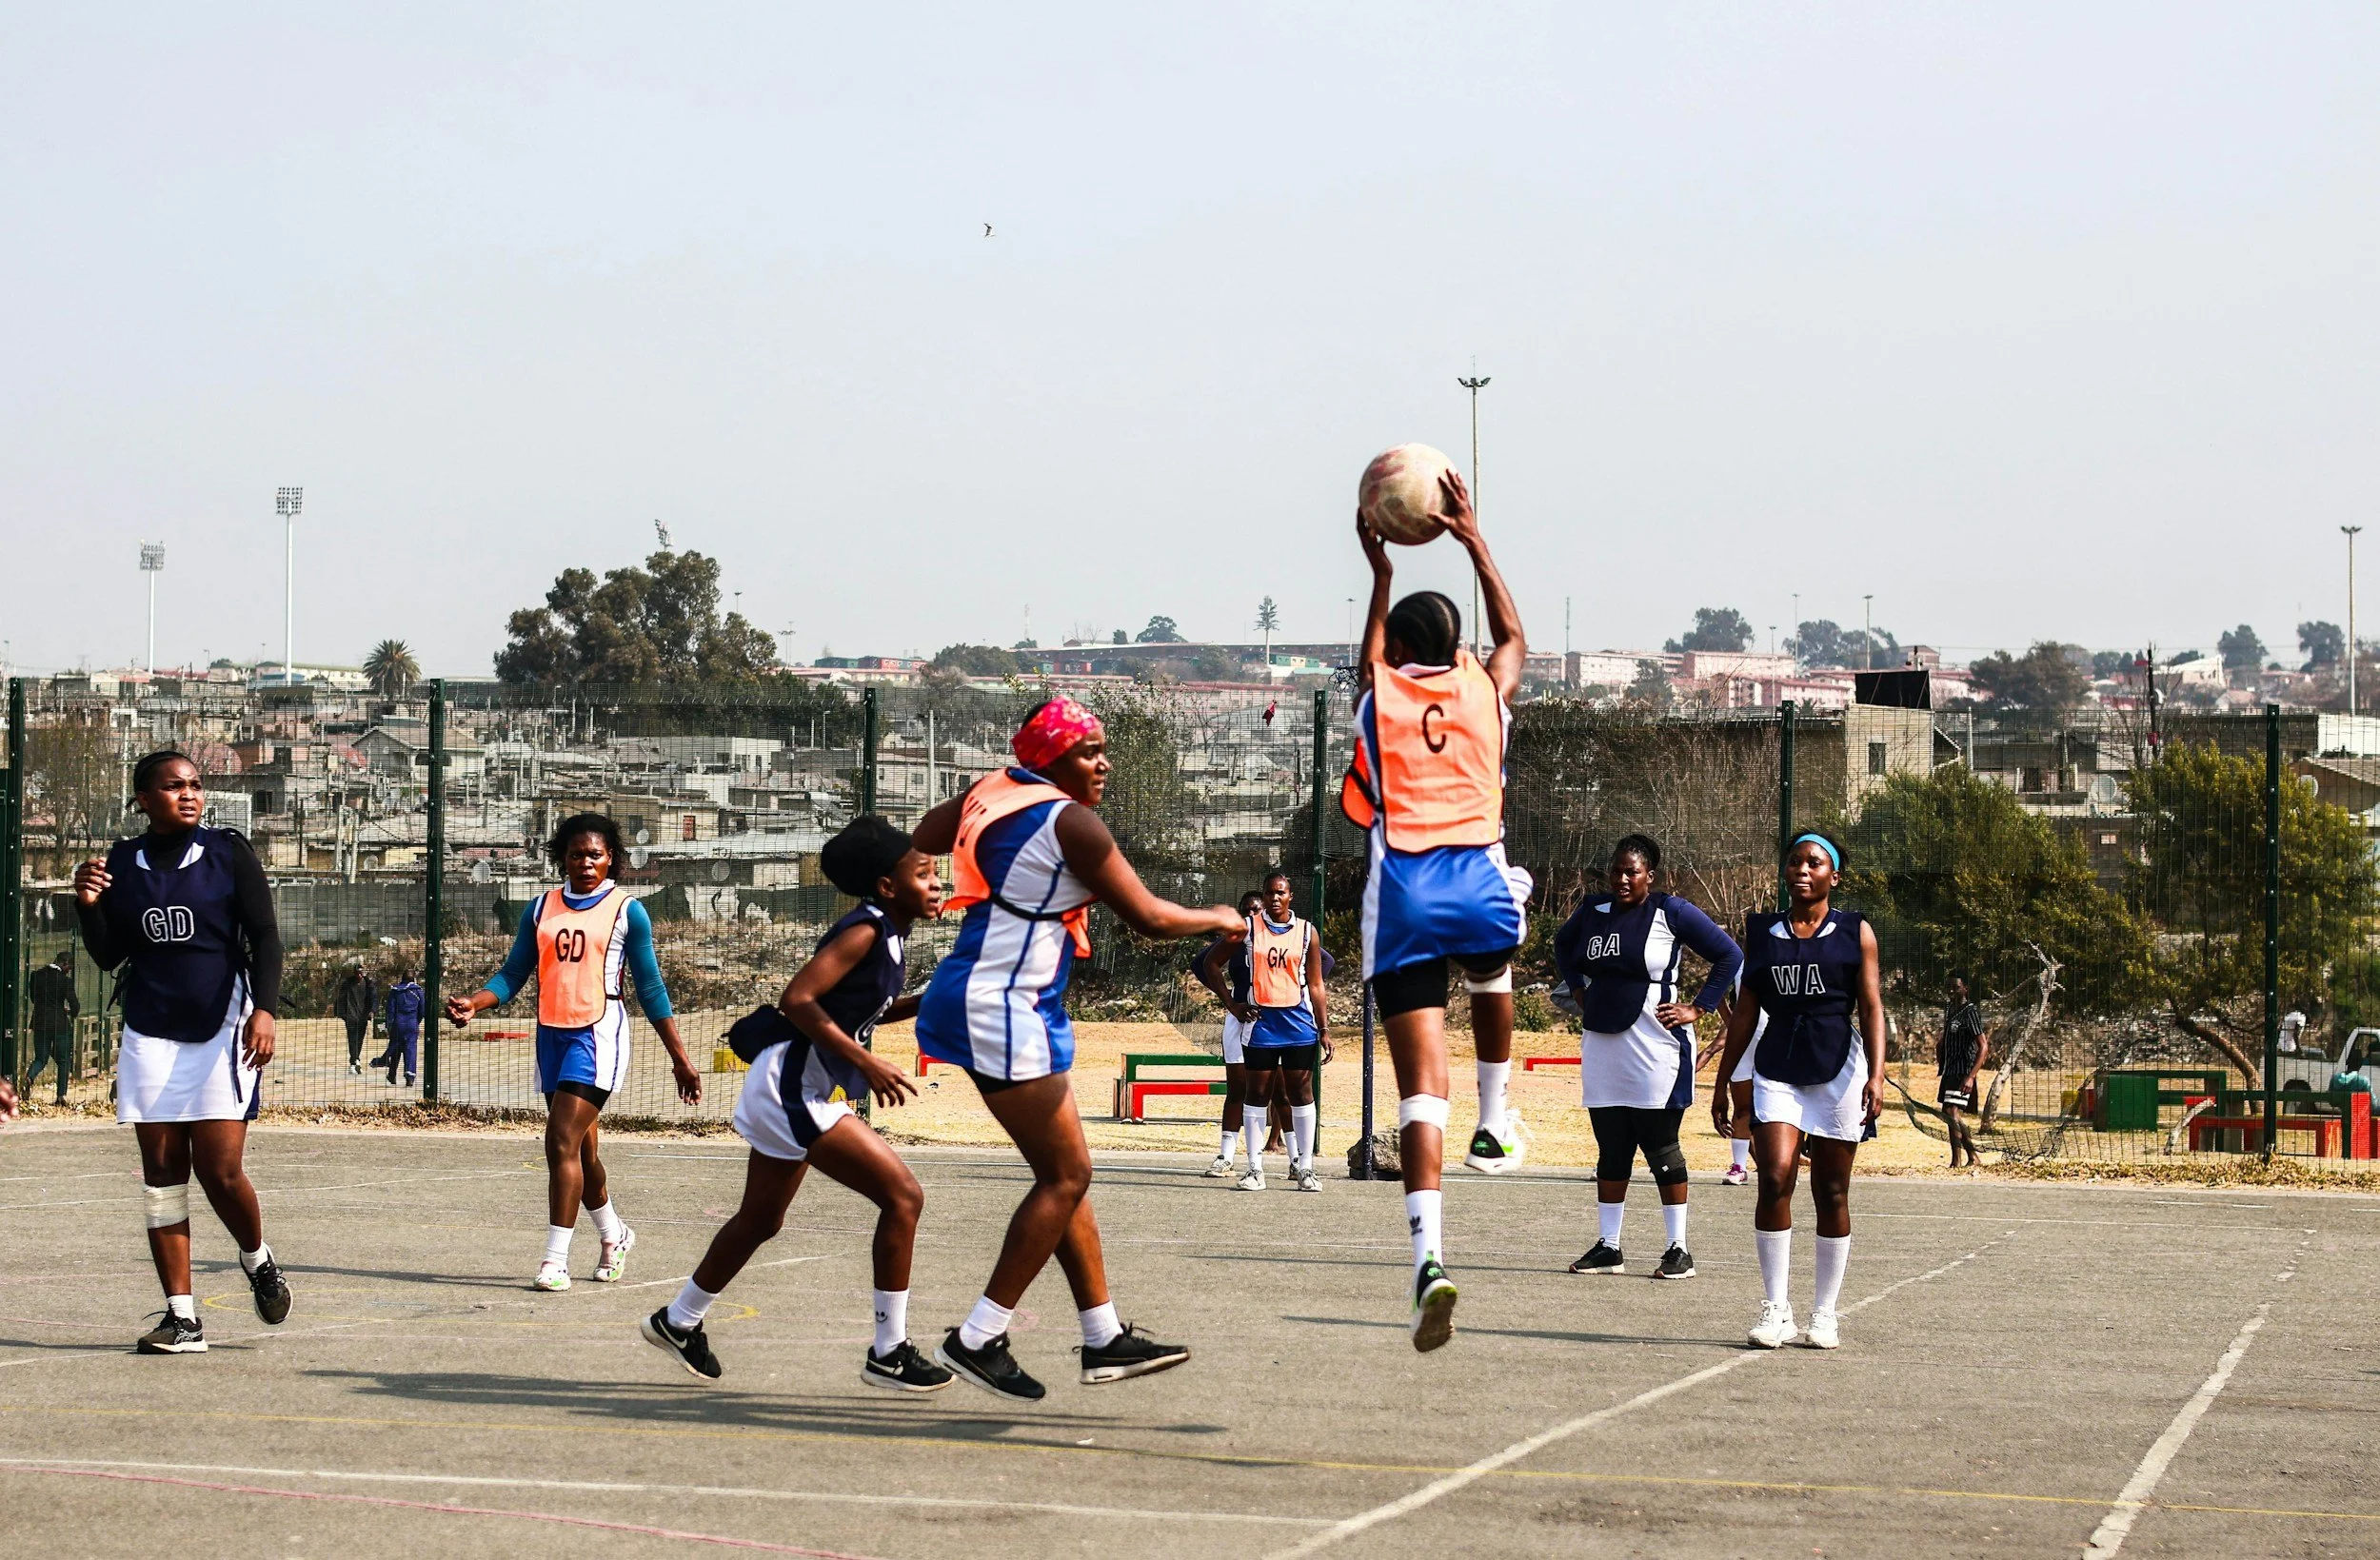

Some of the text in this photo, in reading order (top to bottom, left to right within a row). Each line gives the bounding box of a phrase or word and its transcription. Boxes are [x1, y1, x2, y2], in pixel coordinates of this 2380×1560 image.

[1422, 703, 1447, 754] C
[142, 906, 195, 942] GD
[555, 928, 585, 962] GD
[1267, 946, 1289, 969] GK
[1587, 933, 1620, 960] GA
[1771, 963, 1826, 996] WA
